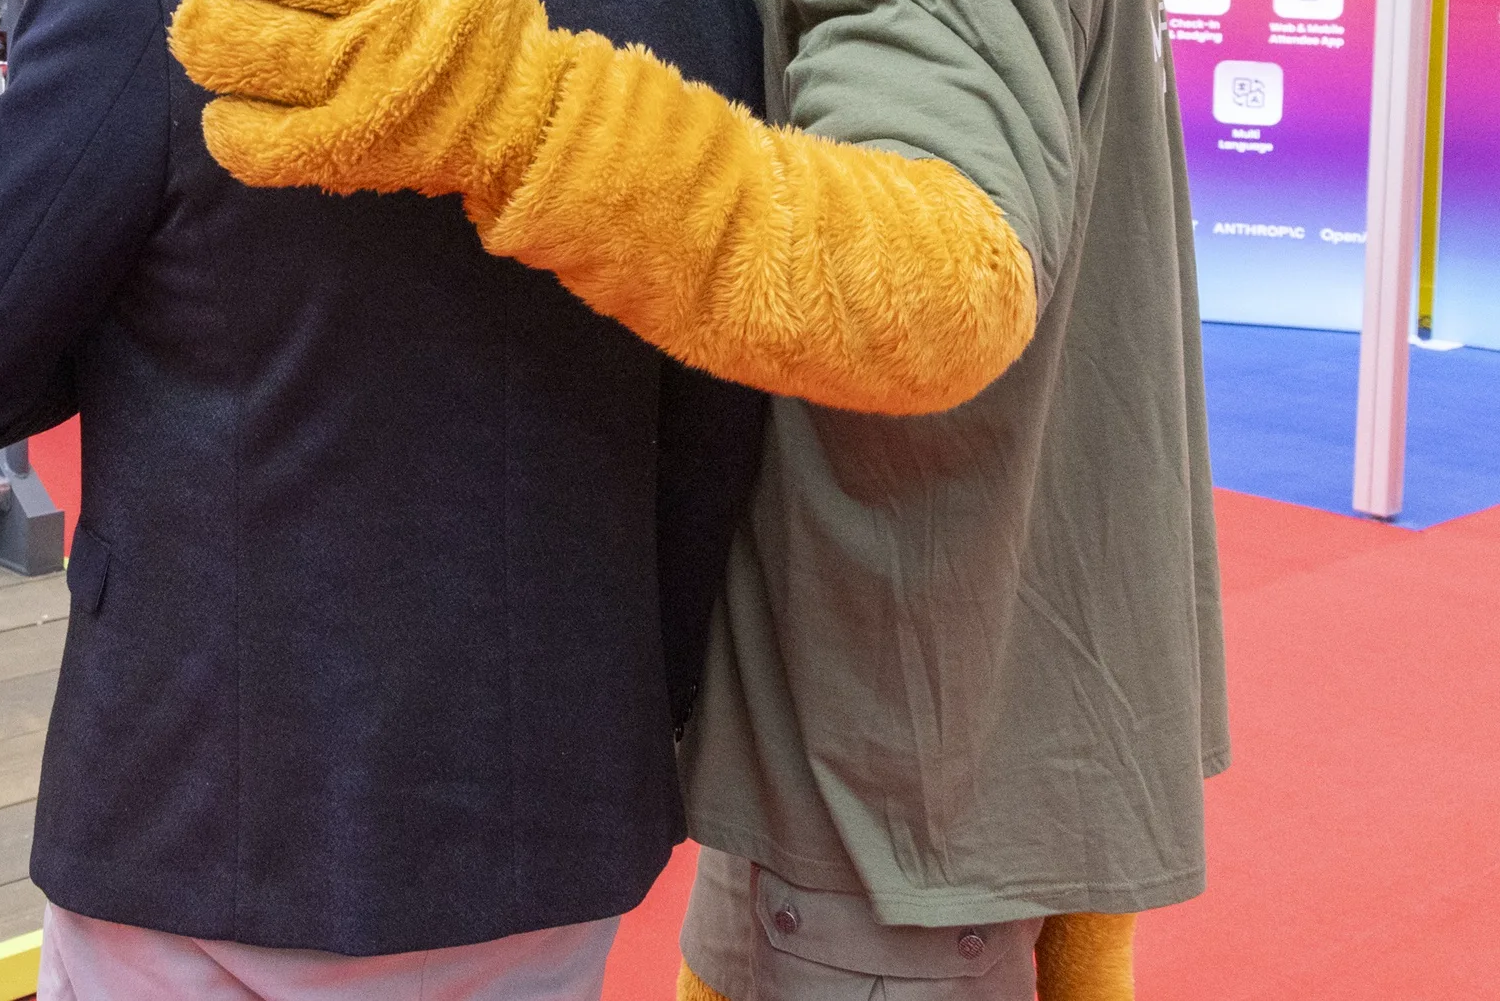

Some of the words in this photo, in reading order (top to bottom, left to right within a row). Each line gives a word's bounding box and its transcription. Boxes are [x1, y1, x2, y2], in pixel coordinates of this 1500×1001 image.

[1169, 18, 1221, 30] Check-in
[1268, 22, 1296, 34] Web
[1307, 24, 1346, 36] Mobile
[1177, 30, 1223, 45] Badging
[1268, 34, 1320, 46] Attendee
[1321, 36, 1346, 49] App
[1231, 128, 1261, 140] Multi
[1218, 140, 1274, 154] Language
